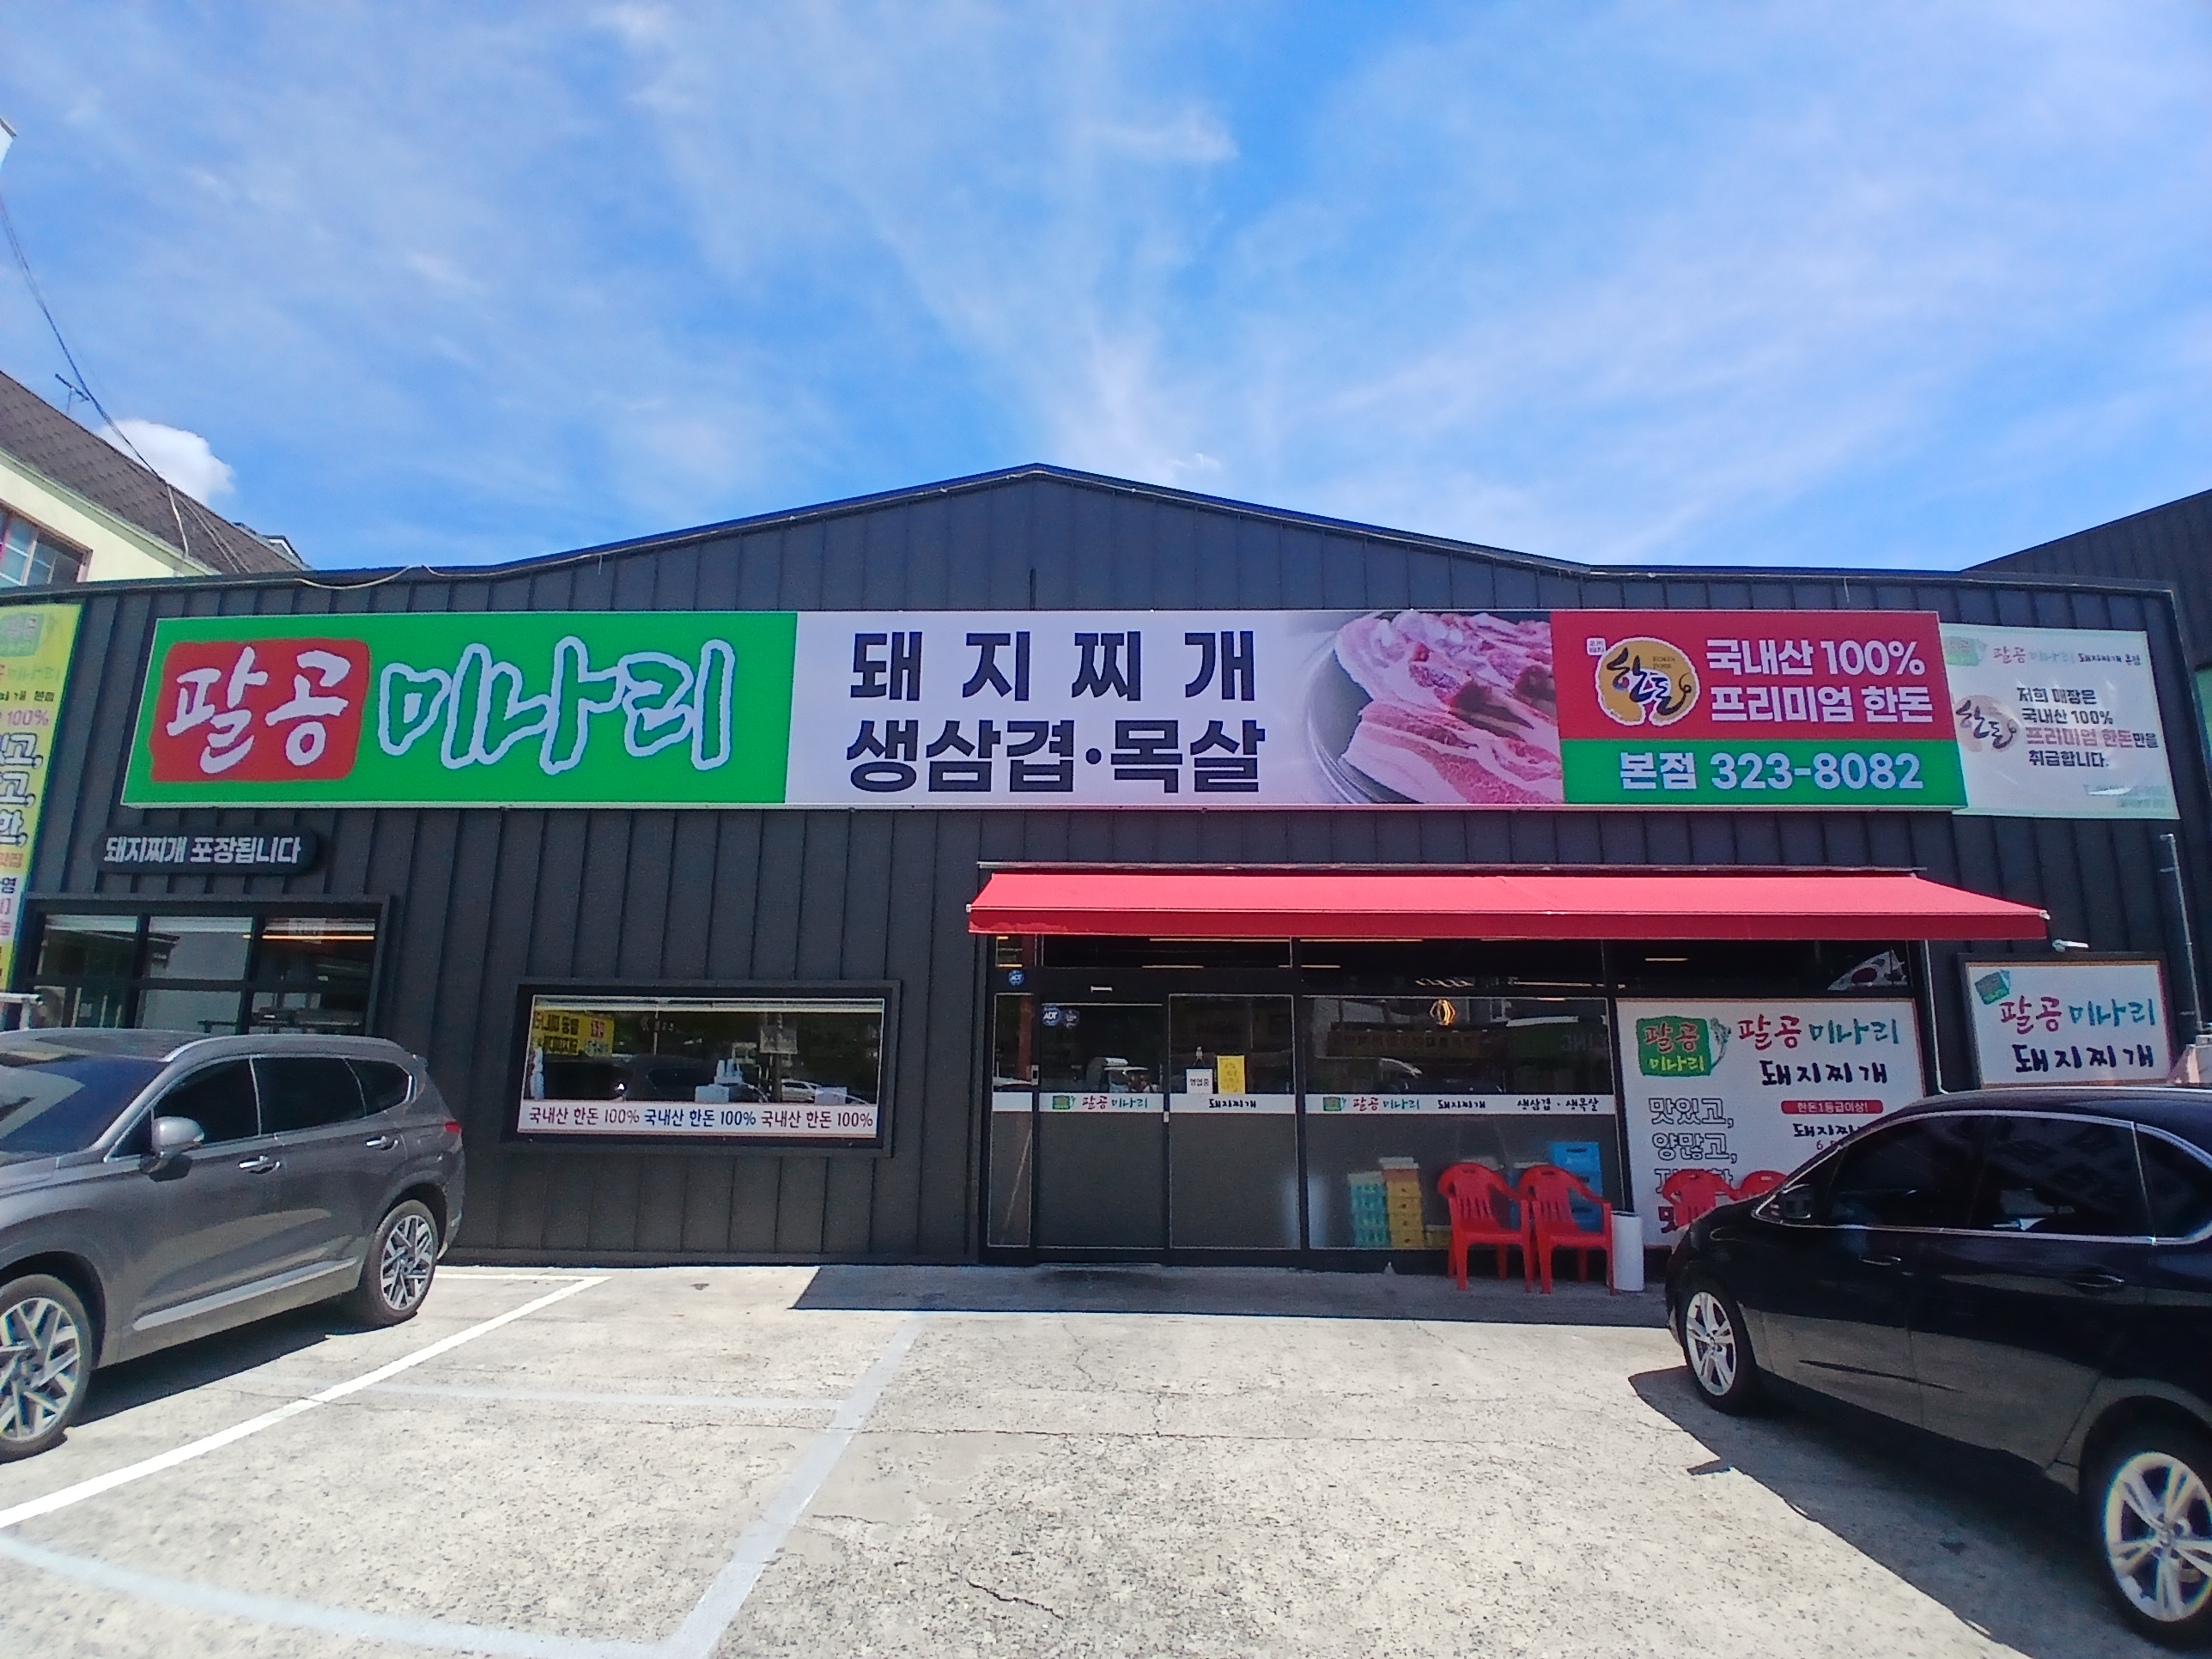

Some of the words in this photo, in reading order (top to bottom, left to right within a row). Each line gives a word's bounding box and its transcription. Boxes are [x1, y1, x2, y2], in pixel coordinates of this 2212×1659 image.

[1705, 639, 1814, 676] 국내산
[1820, 640, 1925, 677] 100%
[167, 647, 350, 773] 팔공
[379, 636, 734, 774] 미나리
[1711, 686, 1852, 723] 프리미엄
[1861, 685, 1934, 724] 한돈
[2016, 687, 2049, 702] 저희
[2051, 688, 2097, 704] 매장은
[7, 709, 49, 726] 100%
[2021, 708, 2067, 725] 국내산
[2071, 710, 2113, 726] 100%
[2025, 726, 2098, 747] 프리미엄
[1620, 751, 1698, 791] 본점
[1710, 752, 1923, 791] 323-8082
[104, 836, 187, 863] 돼지찌개
[191, 836, 301, 864] 포장됩니다
[1999, 995, 2062, 1034] 팔공
[2069, 998, 2155, 1027] 미나리
[1644, 1022, 1700, 1054] 팔공
[1737, 1014, 1802, 1050] 팔공
[1808, 1018, 1899, 1045] 미나리
[1649, 1054, 1705, 1072] 미나리
[2012, 1043, 2154, 1073] 돼지찌개
[1759, 1060, 1888, 1085] 돼지찌개
[1082, 1095, 1108, 1110] 팔공
[1111, 1097, 1148, 1109] 미나리
[1209, 1098, 1256, 1108] 돼지찌개
[1352, 1097, 1378, 1112] 팔공
[1382, 1098, 1419, 1110] 미나리
[1437, 1100, 1486, 1109] 돼지찌개
[1517, 1099, 1551, 1111] 생삼겹
[1565, 1099, 1600, 1112] 생목살
[1649, 1097, 1735, 1128] 맛있고,
[529, 1106, 569, 1124] 국내산
[574, 1107, 599, 1126] 한돈
[605, 1108, 640, 1125] 100%
[644, 1109, 684, 1127] 국내산
[689, 1109, 715, 1127] 한돈
[720, 1110, 757, 1127] 100%
[761, 1109, 802, 1128] 국내산
[806, 1109, 832, 1129] 한돈
[836, 1111, 873, 1127] 100%
[1792, 1122, 1862, 1137] 돼지찌
[1652, 1133, 1737, 1164] 양많고,
